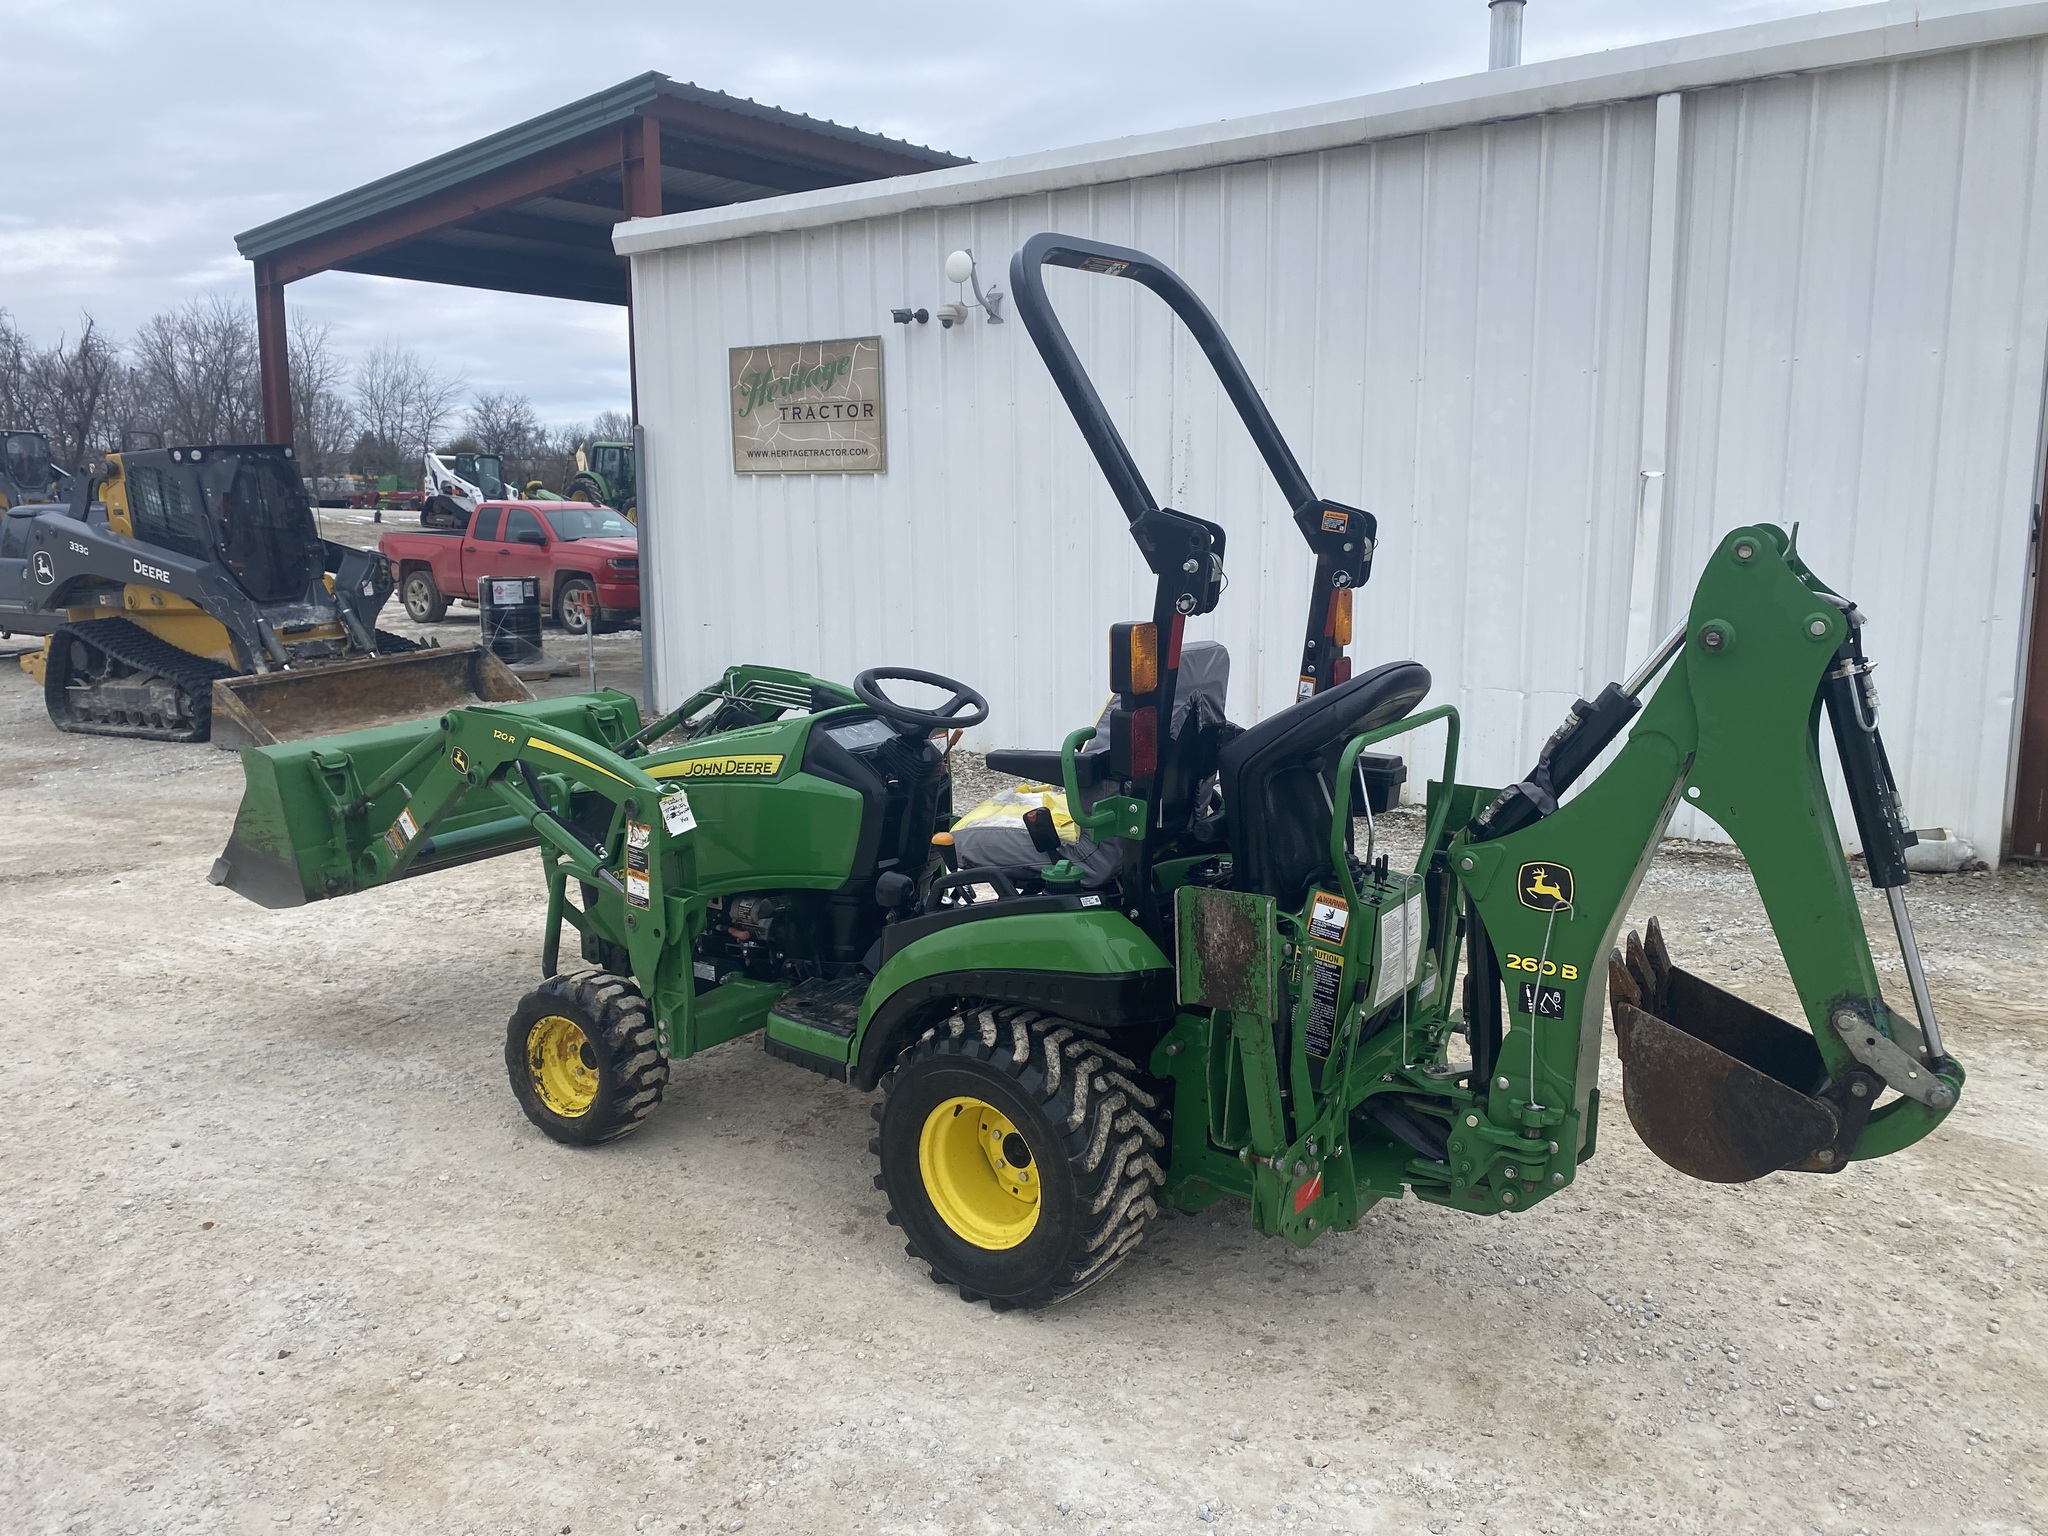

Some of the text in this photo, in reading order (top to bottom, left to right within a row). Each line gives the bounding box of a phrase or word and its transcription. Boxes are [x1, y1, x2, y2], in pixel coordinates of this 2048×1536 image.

[739, 354, 851, 417] Heritage
[779, 403, 873, 421] TRACTOR
[746, 448, 868, 458] WWW.HERITAGETRACTOR.COM
[69, 541, 89, 556] 333G
[133, 559, 171, 584] DEERE
[493, 729, 516, 744] 120 R
[684, 759, 773, 777] JOHN DEERE
[1314, 950, 1340, 964] AUTION
[1506, 953, 1578, 981] 260 B
